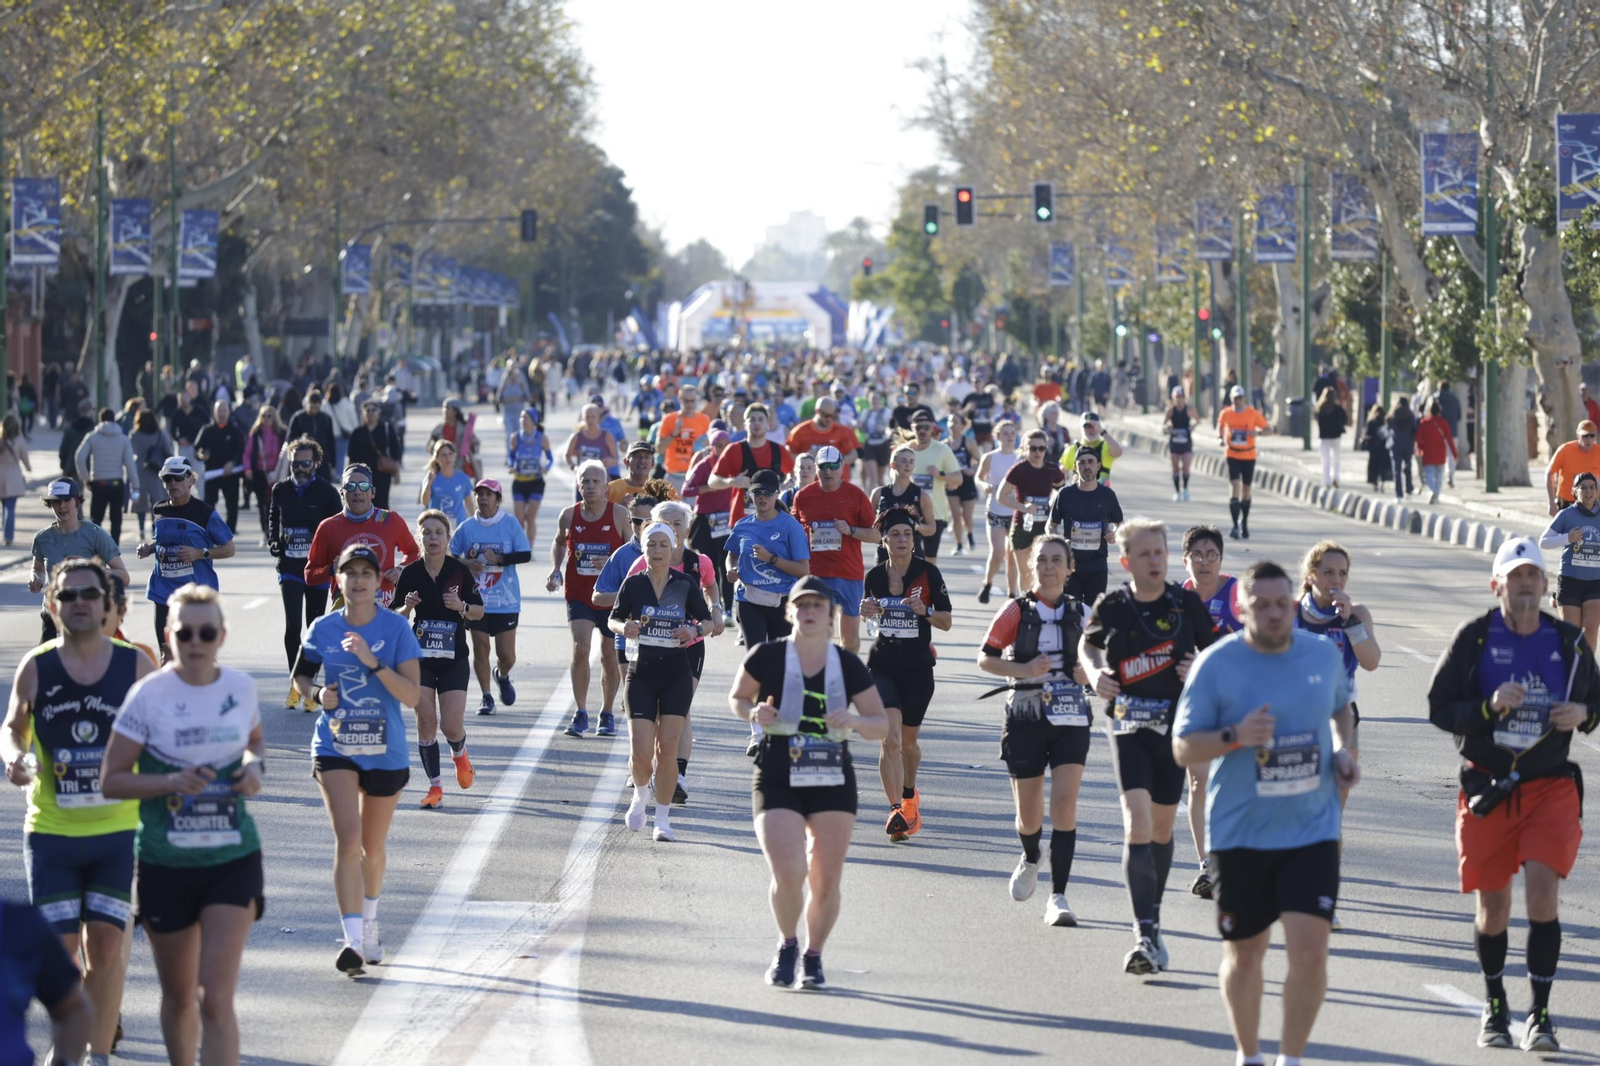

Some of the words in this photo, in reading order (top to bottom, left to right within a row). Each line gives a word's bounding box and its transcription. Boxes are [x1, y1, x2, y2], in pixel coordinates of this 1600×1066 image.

[160, 561, 193, 570] SPACEMAN
[880, 619, 918, 628] LAURENCE
[425, 640, 444, 649] LAIA
[1052, 702, 1080, 714] CÉCILE
[1507, 720, 1543, 735] CHRIS
[60, 780, 79, 793] TRI
[174, 816, 233, 831] COURTEL
